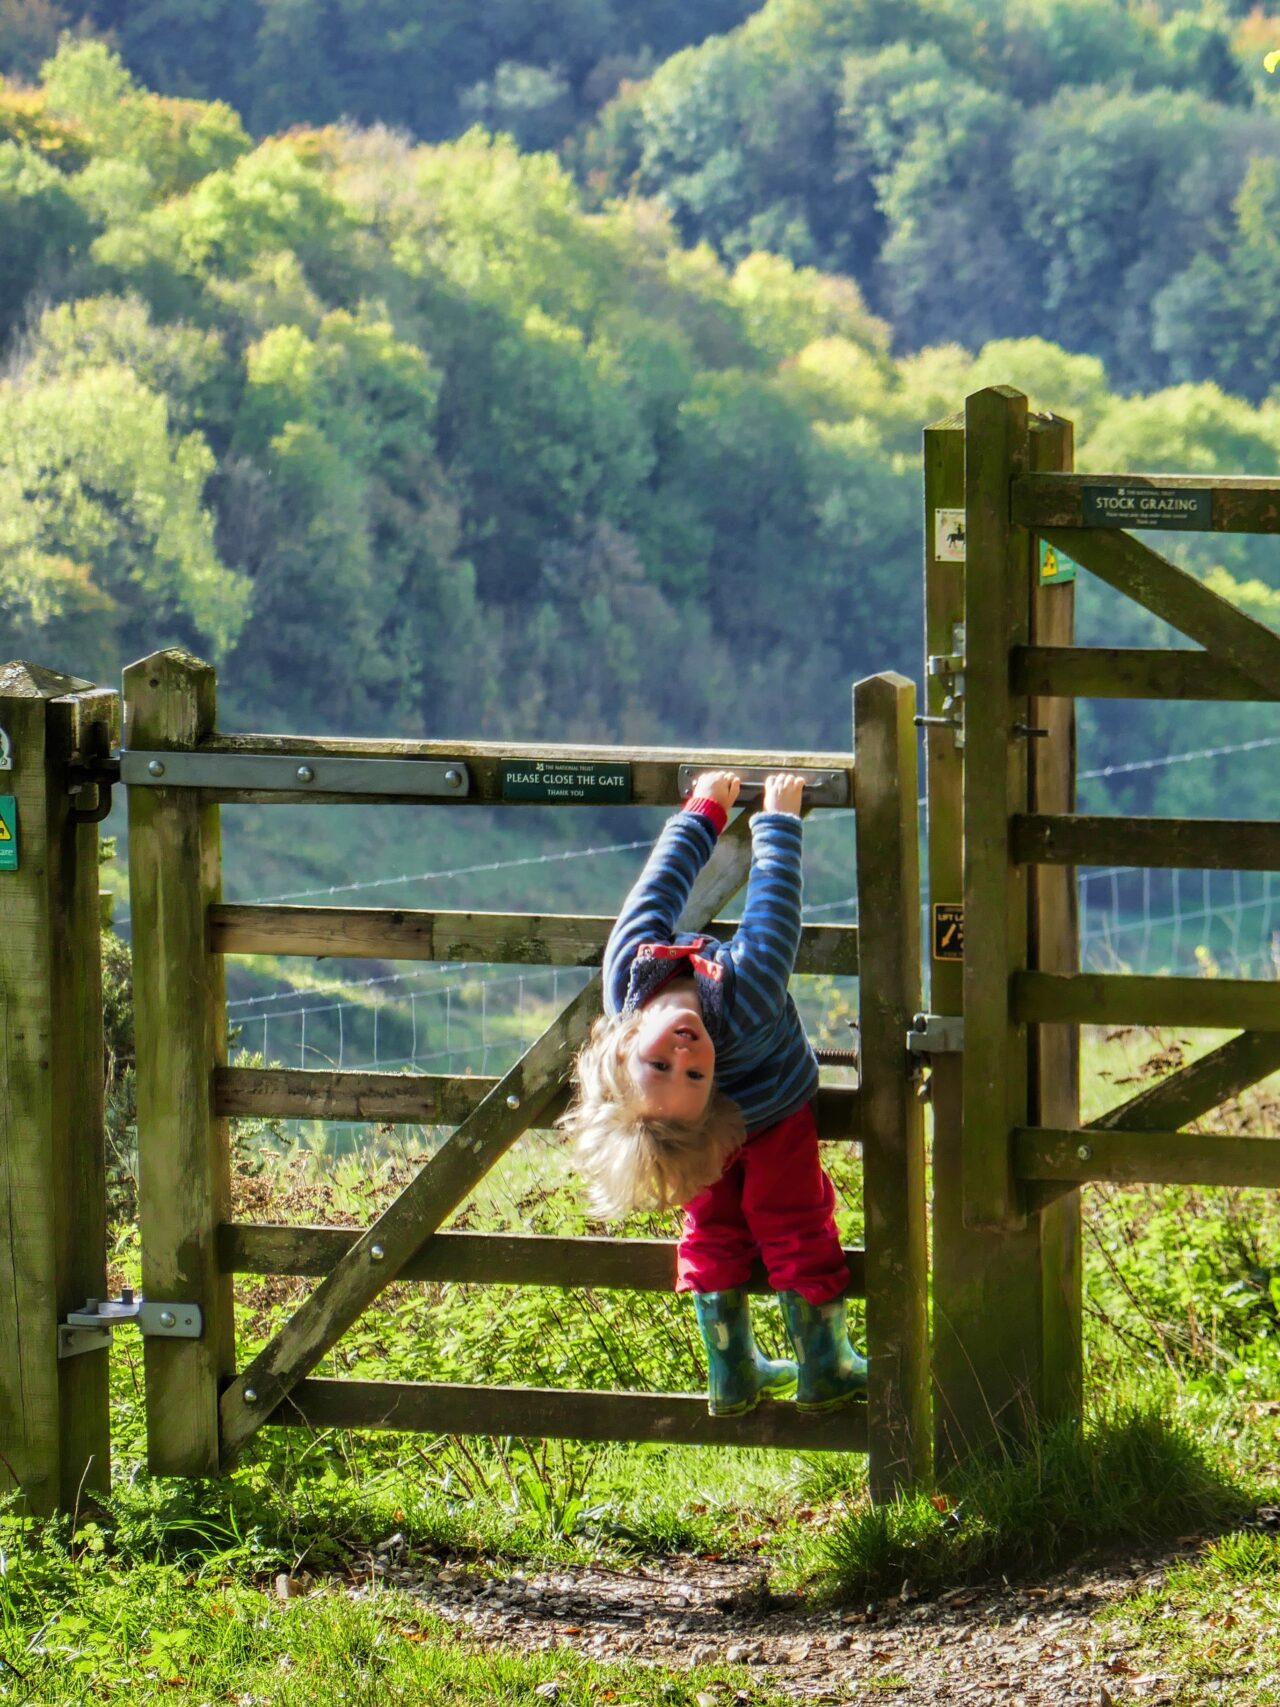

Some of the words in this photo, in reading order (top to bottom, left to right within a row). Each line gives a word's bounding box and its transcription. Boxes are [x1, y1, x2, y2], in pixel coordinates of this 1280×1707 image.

[1095, 497, 1135, 509] STOCK
[1140, 498, 1198, 511] GRAZING
[506, 773, 540, 784] PLEASE
[542, 774, 574, 785] CLOSE
[577, 775, 595, 785] THE
[598, 776, 625, 786] GATE
